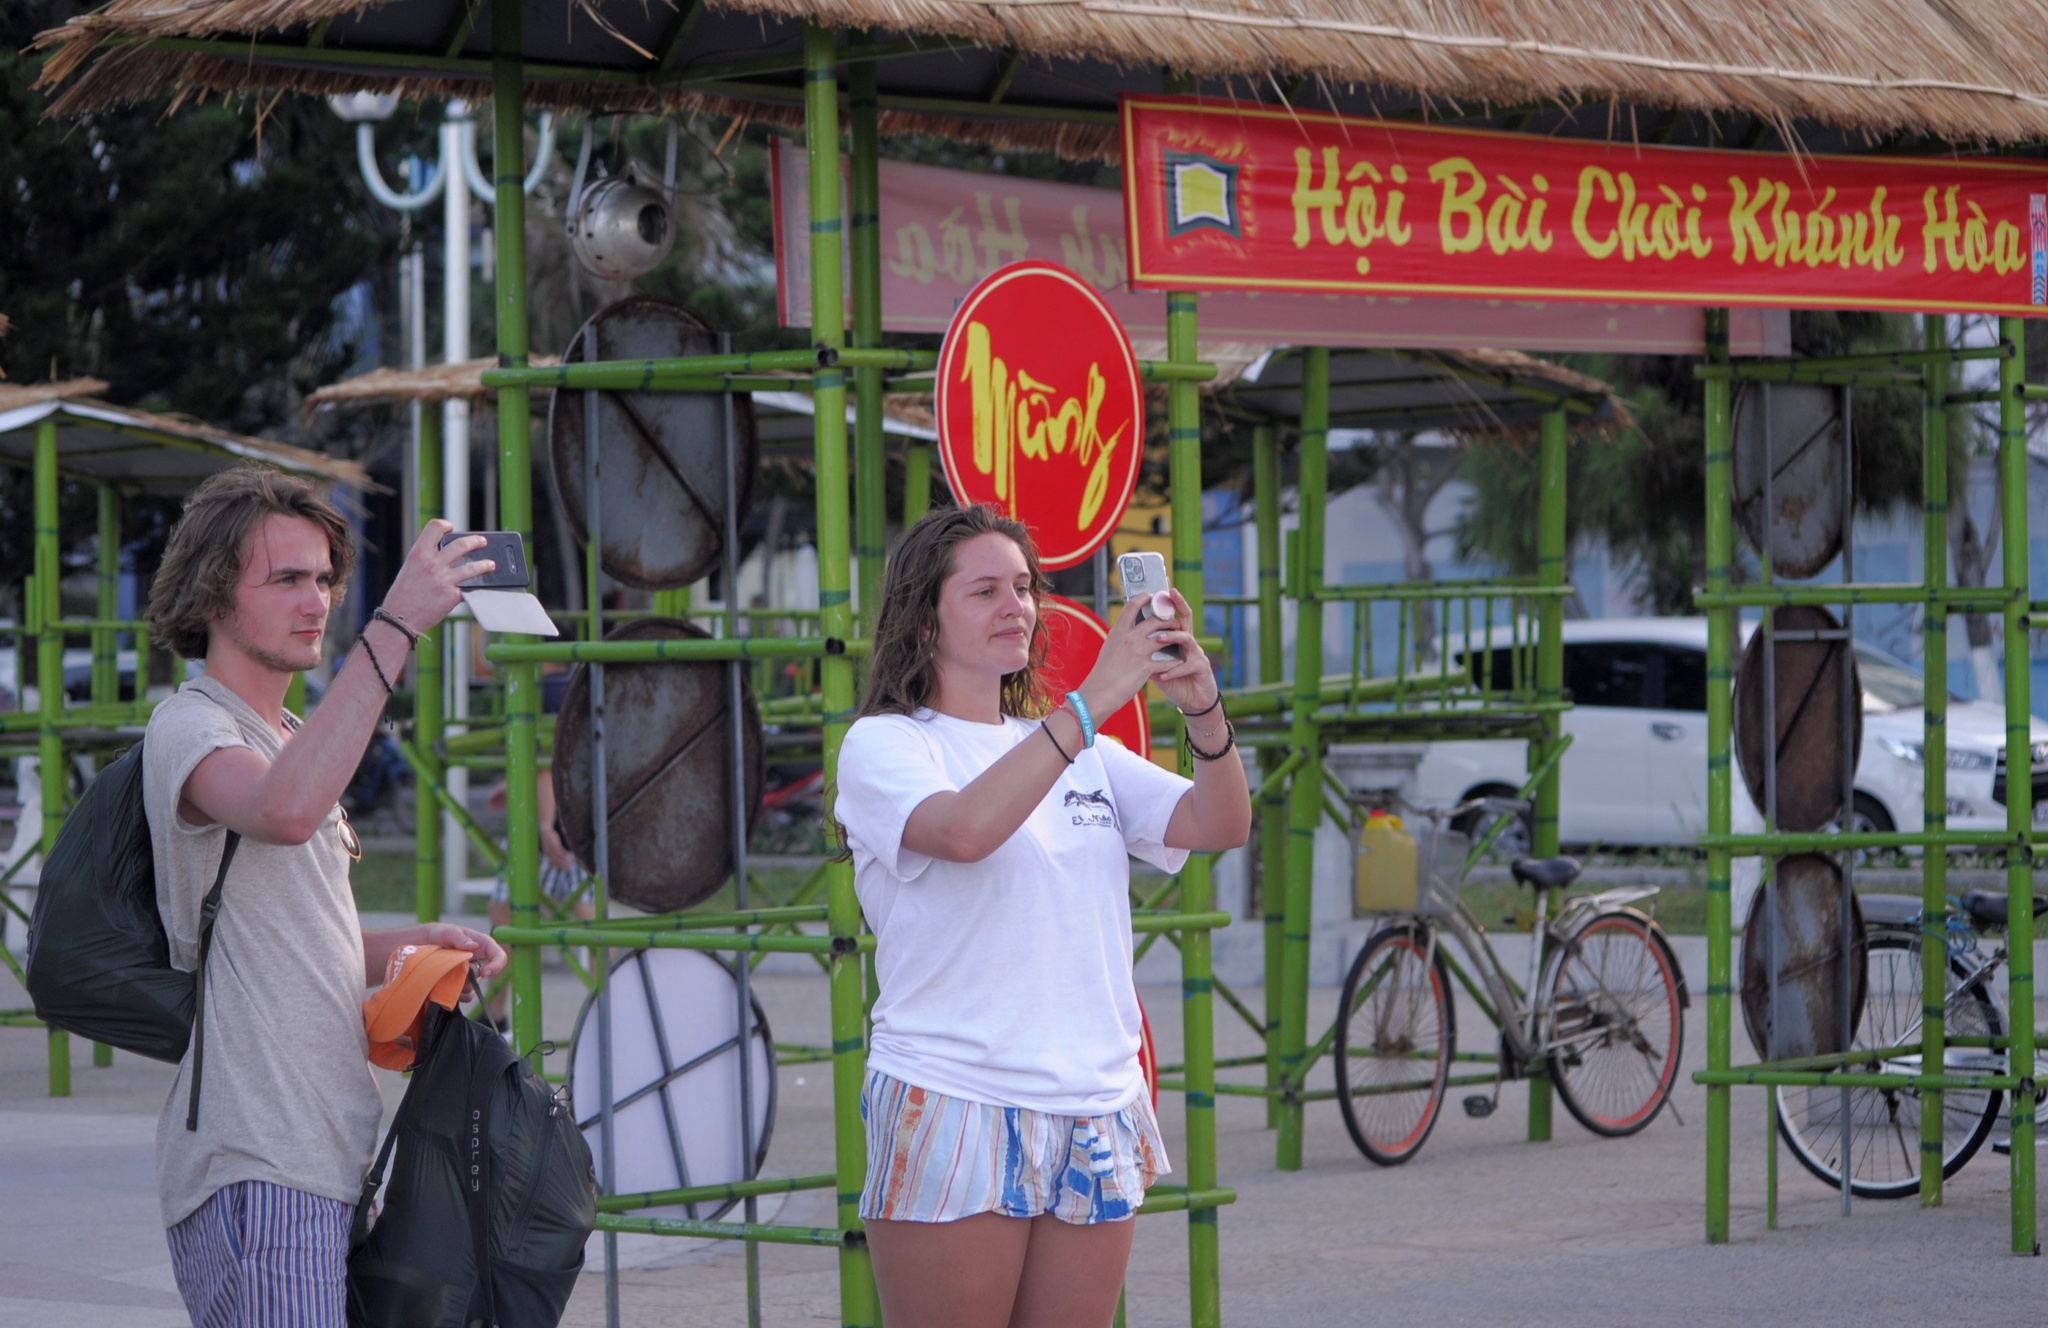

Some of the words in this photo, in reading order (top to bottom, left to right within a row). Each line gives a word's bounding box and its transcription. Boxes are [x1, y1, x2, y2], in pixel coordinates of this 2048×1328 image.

[1292, 146, 1411, 275] Hội
[1430, 157, 1553, 256] Bài
[1729, 175, 1905, 270] Khánh
[1924, 184, 2027, 276] Hòa
